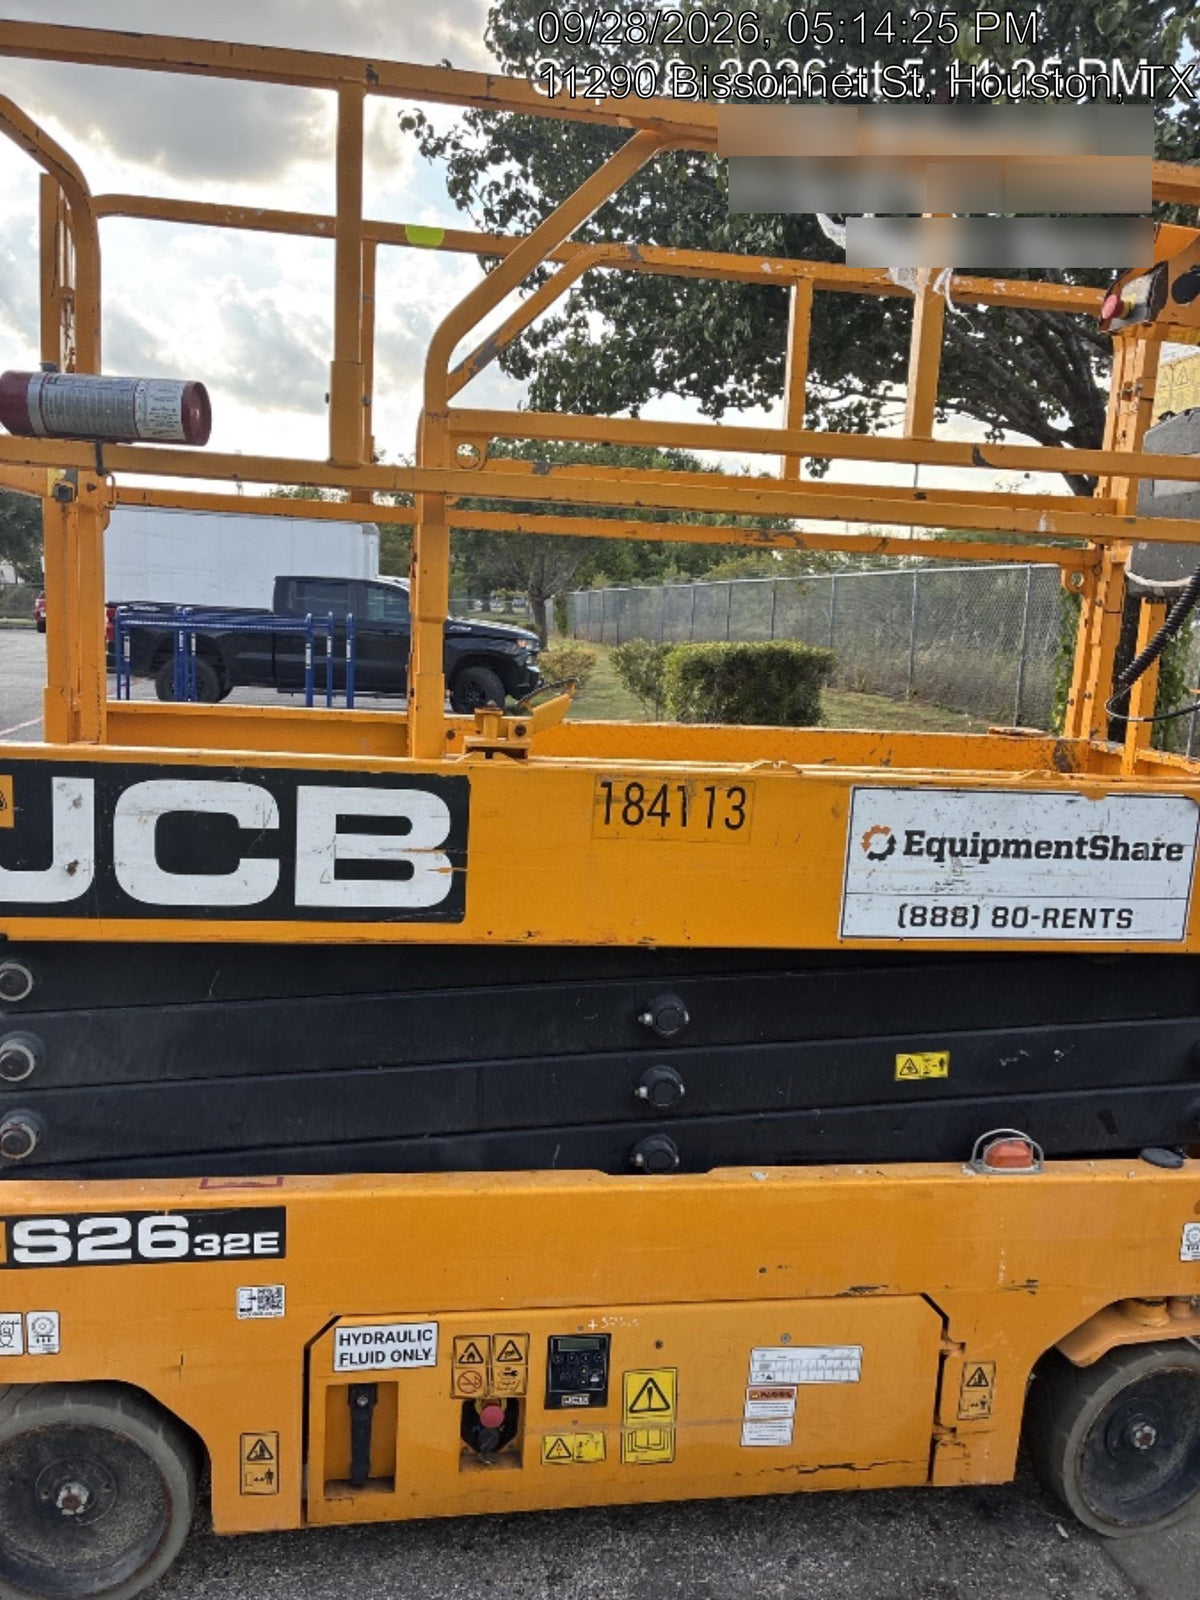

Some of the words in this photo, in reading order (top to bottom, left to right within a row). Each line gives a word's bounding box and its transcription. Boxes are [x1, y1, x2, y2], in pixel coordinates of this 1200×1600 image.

[601, 781, 747, 831] 184113
[0, 777, 453, 908] JCB
[902, 830, 1185, 864] EquipmentShare
[897, 902, 980, 929] (888)
[991, 905, 1134, 930] 80-RENTS
[339, 1329, 433, 1347] HYDRAULIC
[339, 1350, 386, 1367] FLUID
[390, 1347, 432, 1363] ONLY
